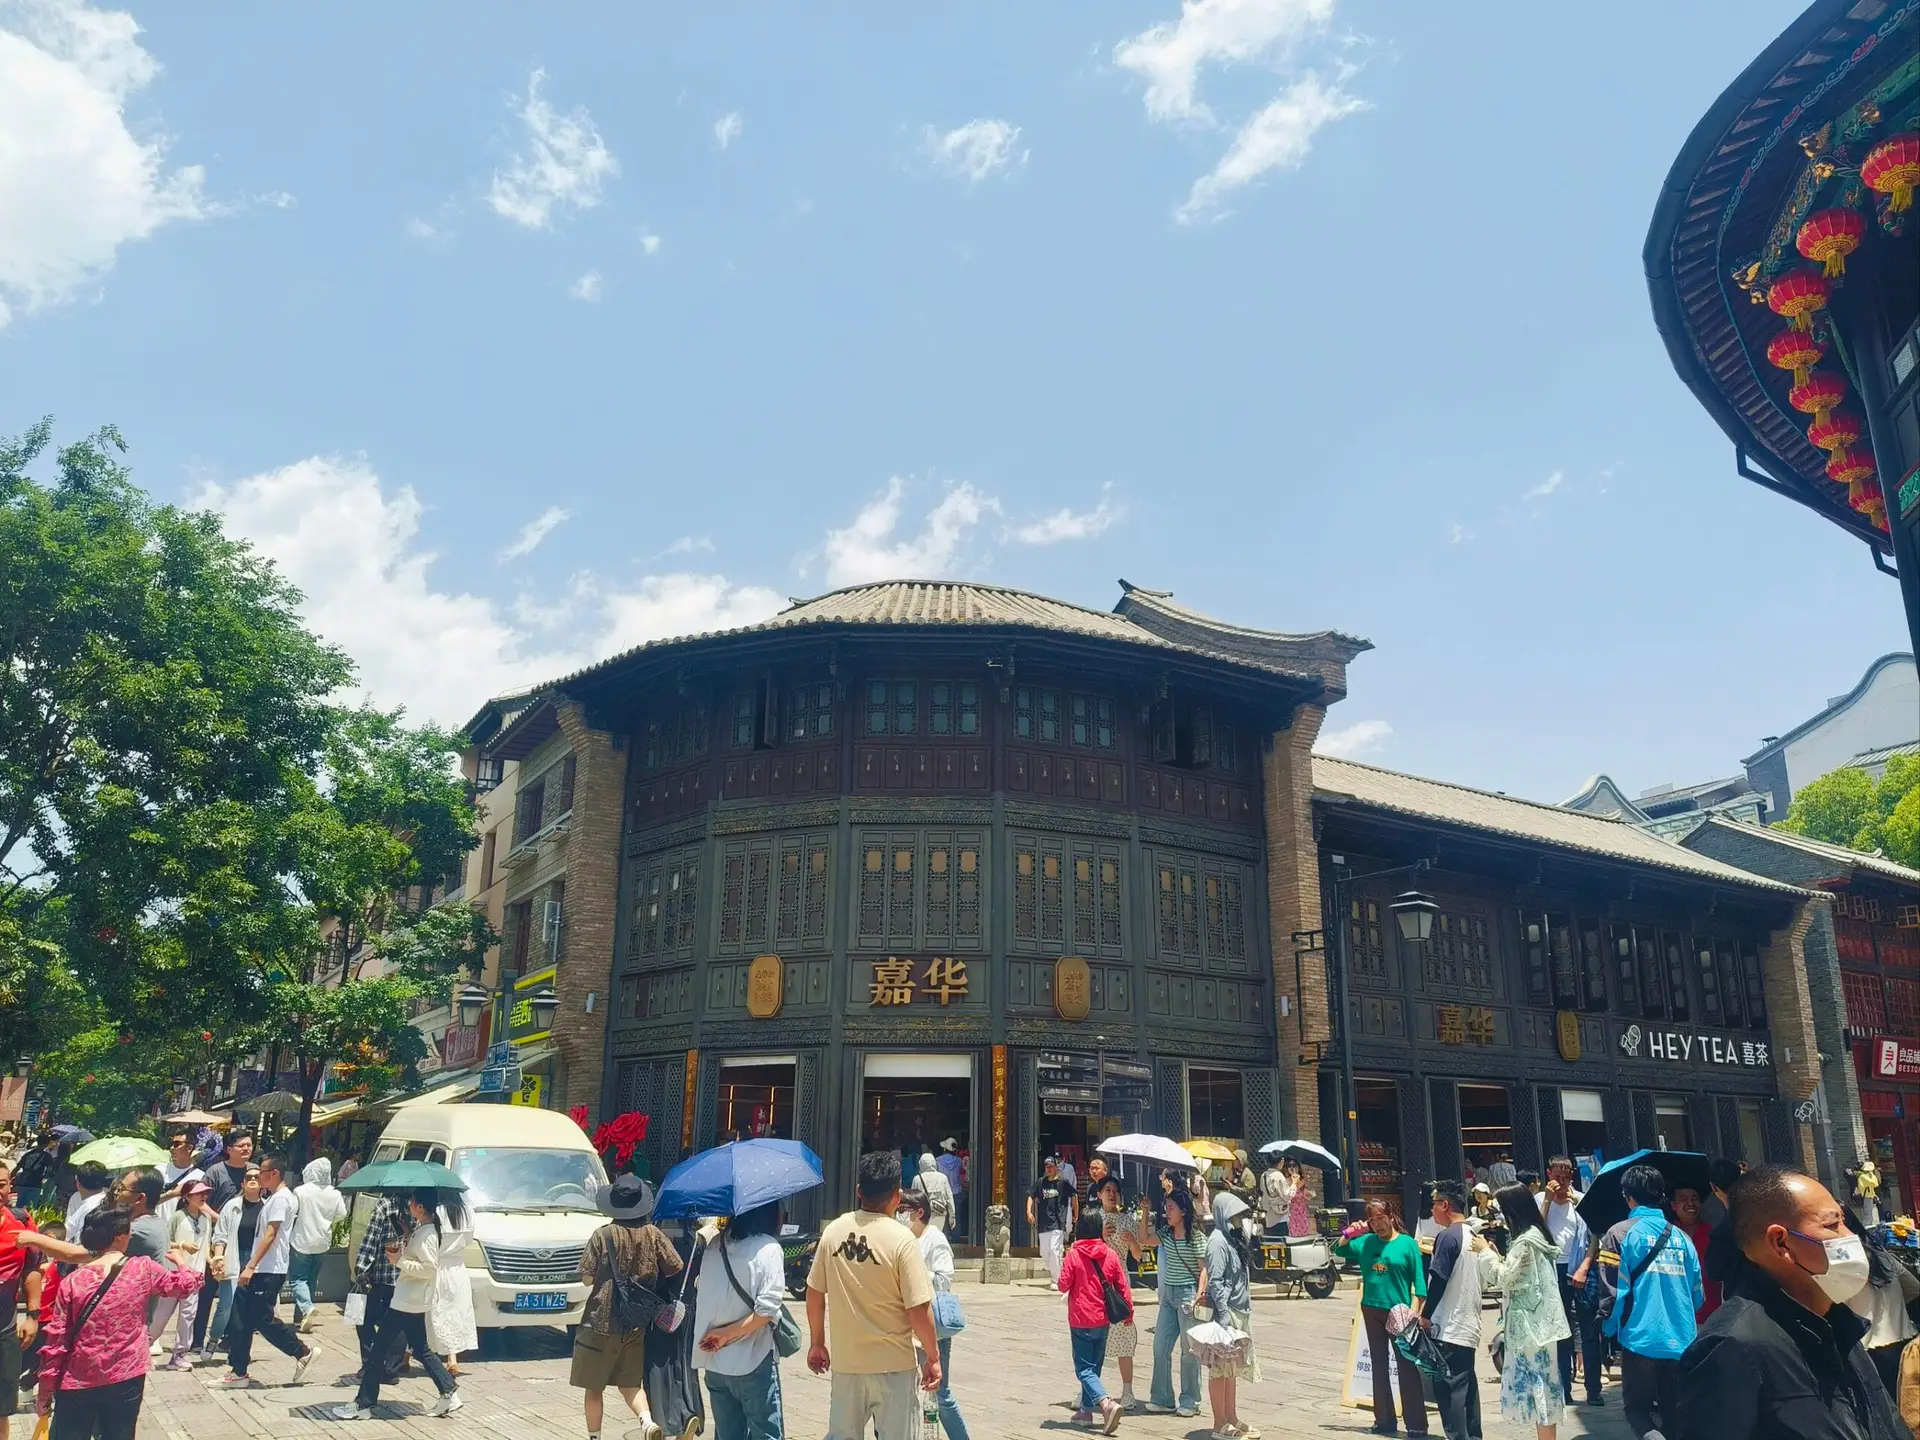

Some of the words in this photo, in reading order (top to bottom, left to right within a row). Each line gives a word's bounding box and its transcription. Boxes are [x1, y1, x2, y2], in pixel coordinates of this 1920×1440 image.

[869, 956, 968, 1006] 嘉华
[1438, 1003, 1494, 1046] 嘉华
[1649, 1031, 1692, 1060] HEY
[1698, 1036, 1739, 1064] TEA
[1742, 1041, 1769, 1067] 喜茶
